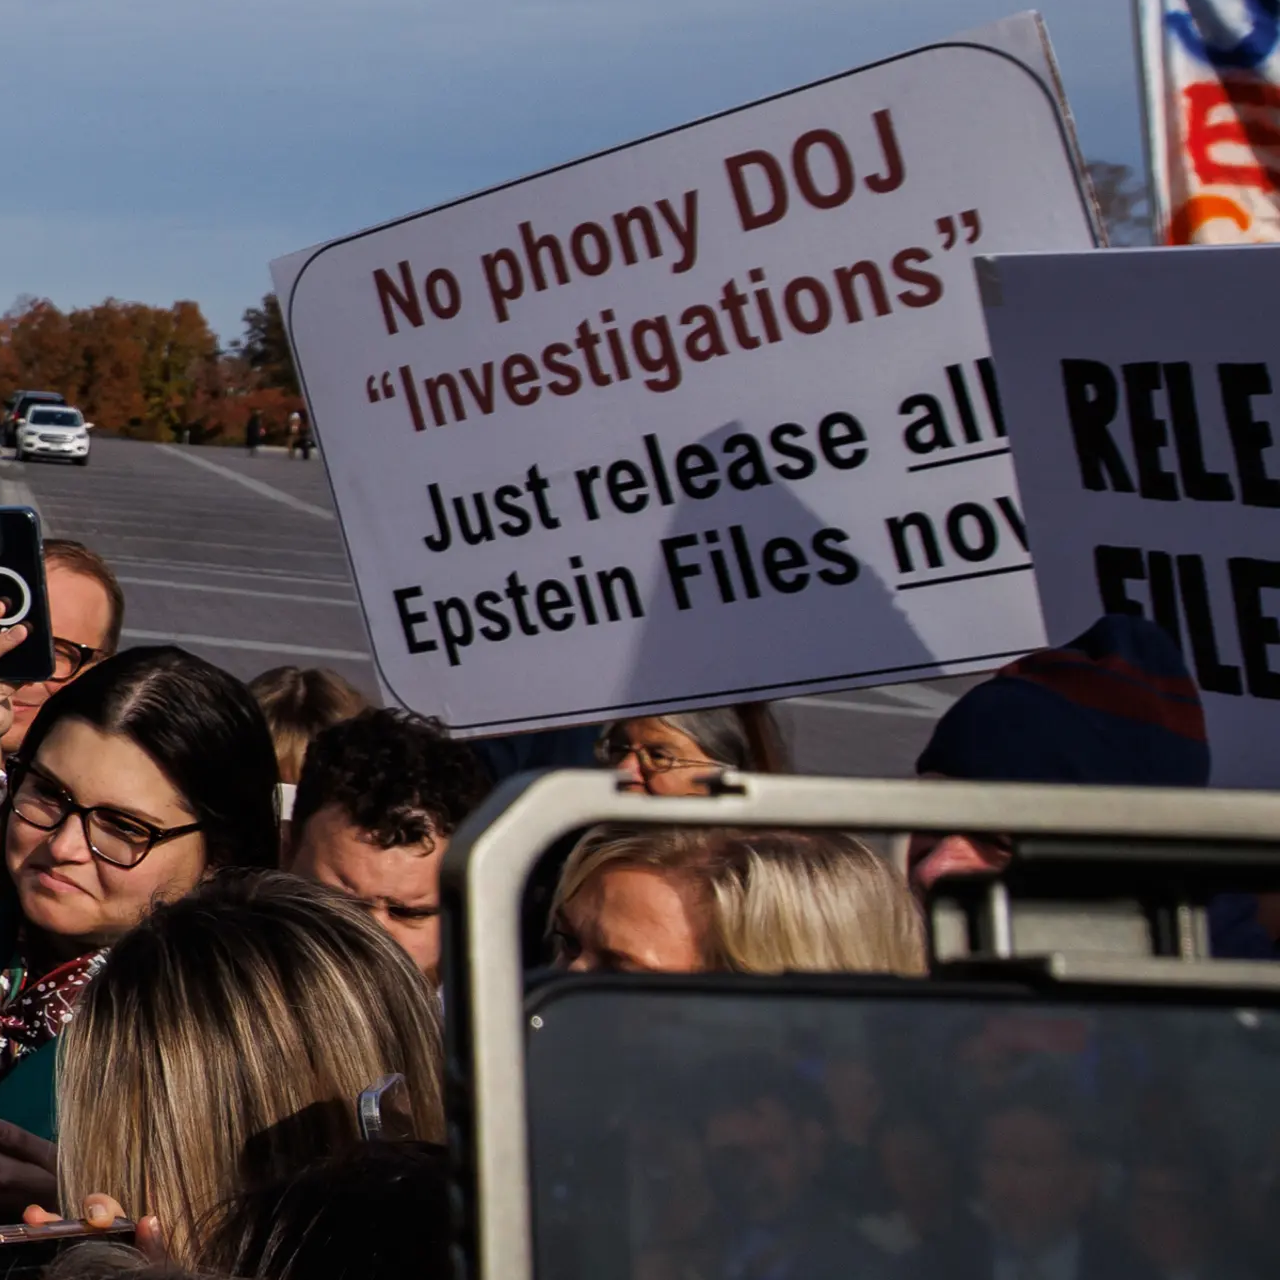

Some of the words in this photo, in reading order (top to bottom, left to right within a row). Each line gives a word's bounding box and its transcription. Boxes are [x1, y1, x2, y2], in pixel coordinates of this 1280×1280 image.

[365, 209, 983, 432] “Investigations”
[371, 260, 462, 336] No
[479, 190, 699, 324] phony
[724, 108, 906, 232] DOJ
[422, 463, 562, 553] Just
[573, 411, 869, 522] release
[897, 356, 1009, 455] all
[391, 566, 645, 668] Epstein
[659, 524, 861, 612] Files
